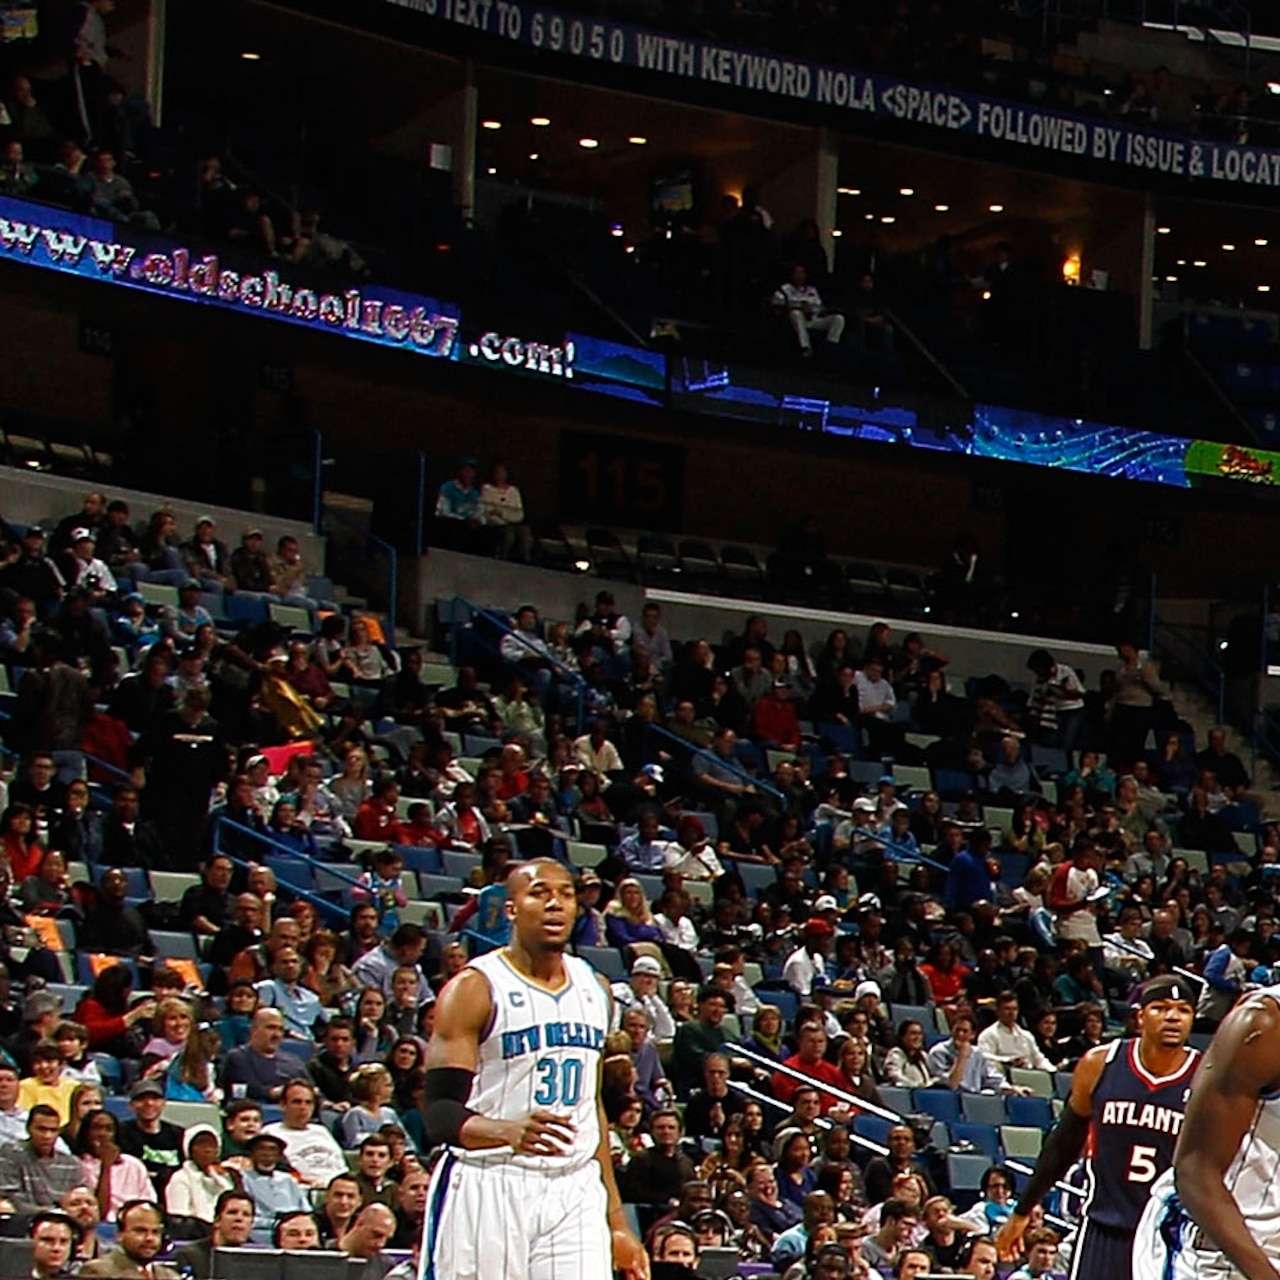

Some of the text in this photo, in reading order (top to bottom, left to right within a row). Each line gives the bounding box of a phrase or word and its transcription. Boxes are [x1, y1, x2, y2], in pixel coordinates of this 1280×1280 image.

[497, 2, 522, 40] TO
[637, 32, 697, 77] WITH
[700, 46, 811, 99] KEYWORD
[816, 68, 877, 113] NOLA
[881, 84, 972, 130] <SPACE>
[977, 102, 1087, 155] FOLLOWED
[1092, 126, 1122, 162] BY
[1125, 133, 1185, 176] ISSUE
[1188, 145, 1204, 177] &
[534, 1057, 583, 1107] 30
[1102, 1101, 1185, 1136] ATLANT
[1128, 1145, 1157, 1184] 5
